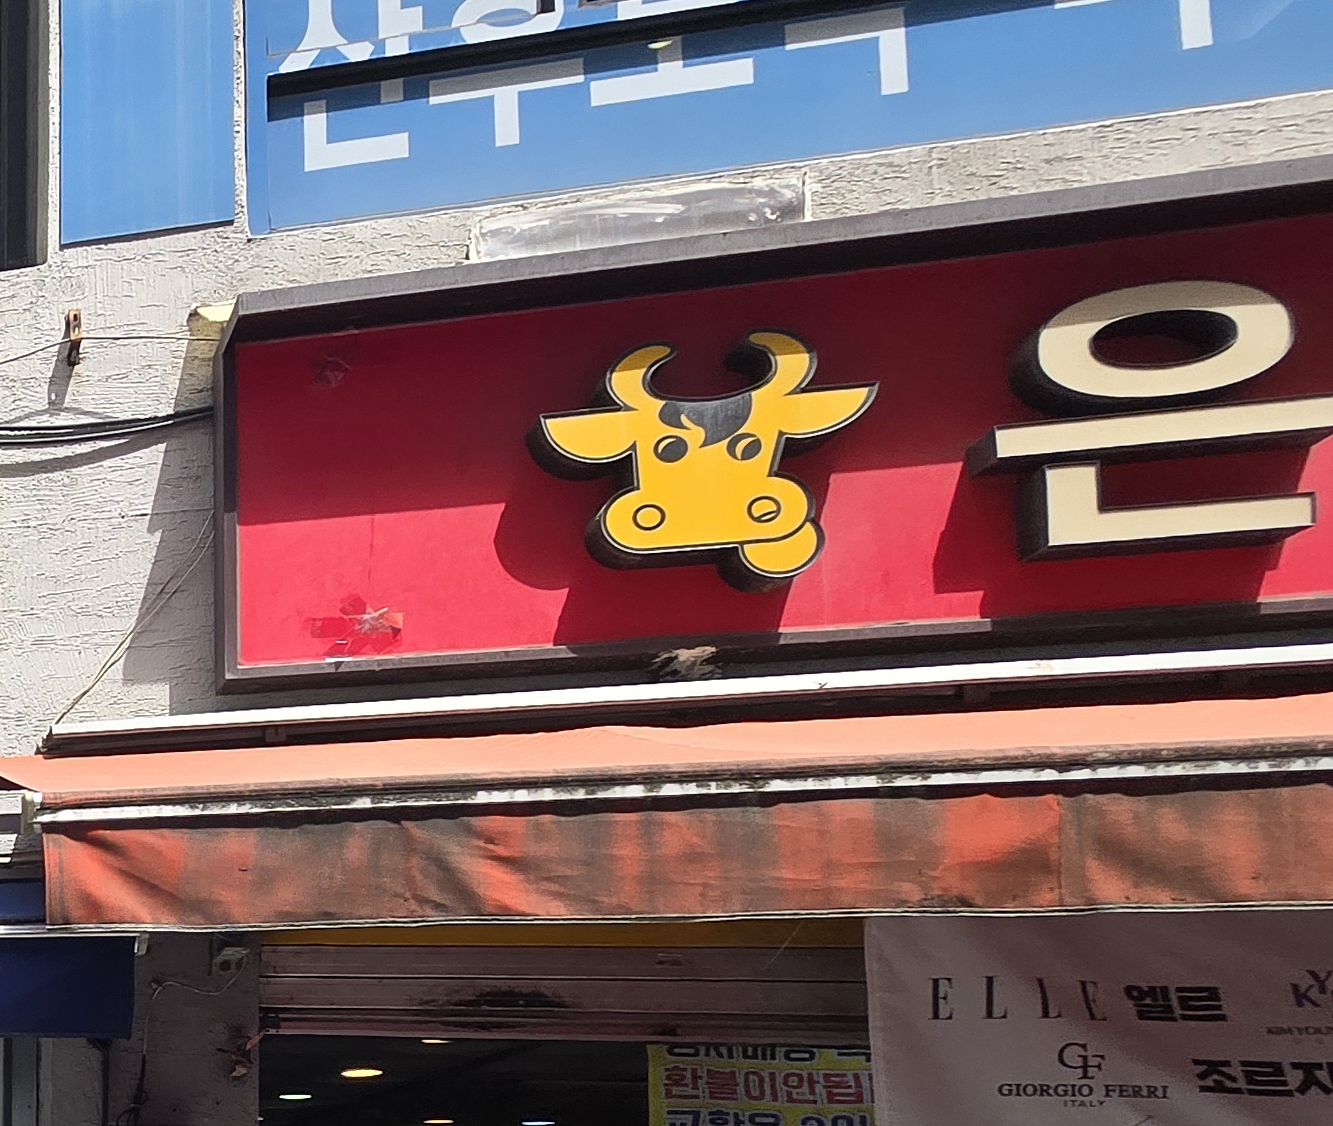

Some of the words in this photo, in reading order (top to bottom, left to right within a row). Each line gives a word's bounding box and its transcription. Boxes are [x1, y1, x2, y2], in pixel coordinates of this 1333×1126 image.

[927, 974, 1108, 1021] ELLE
[1124, 983, 1229, 1023] 엘르
[663, 1065, 876, 1105] 환불이안됩
[997, 1082, 1094, 1099] GIORGIO
[1103, 1083, 1170, 1101] FERRI
